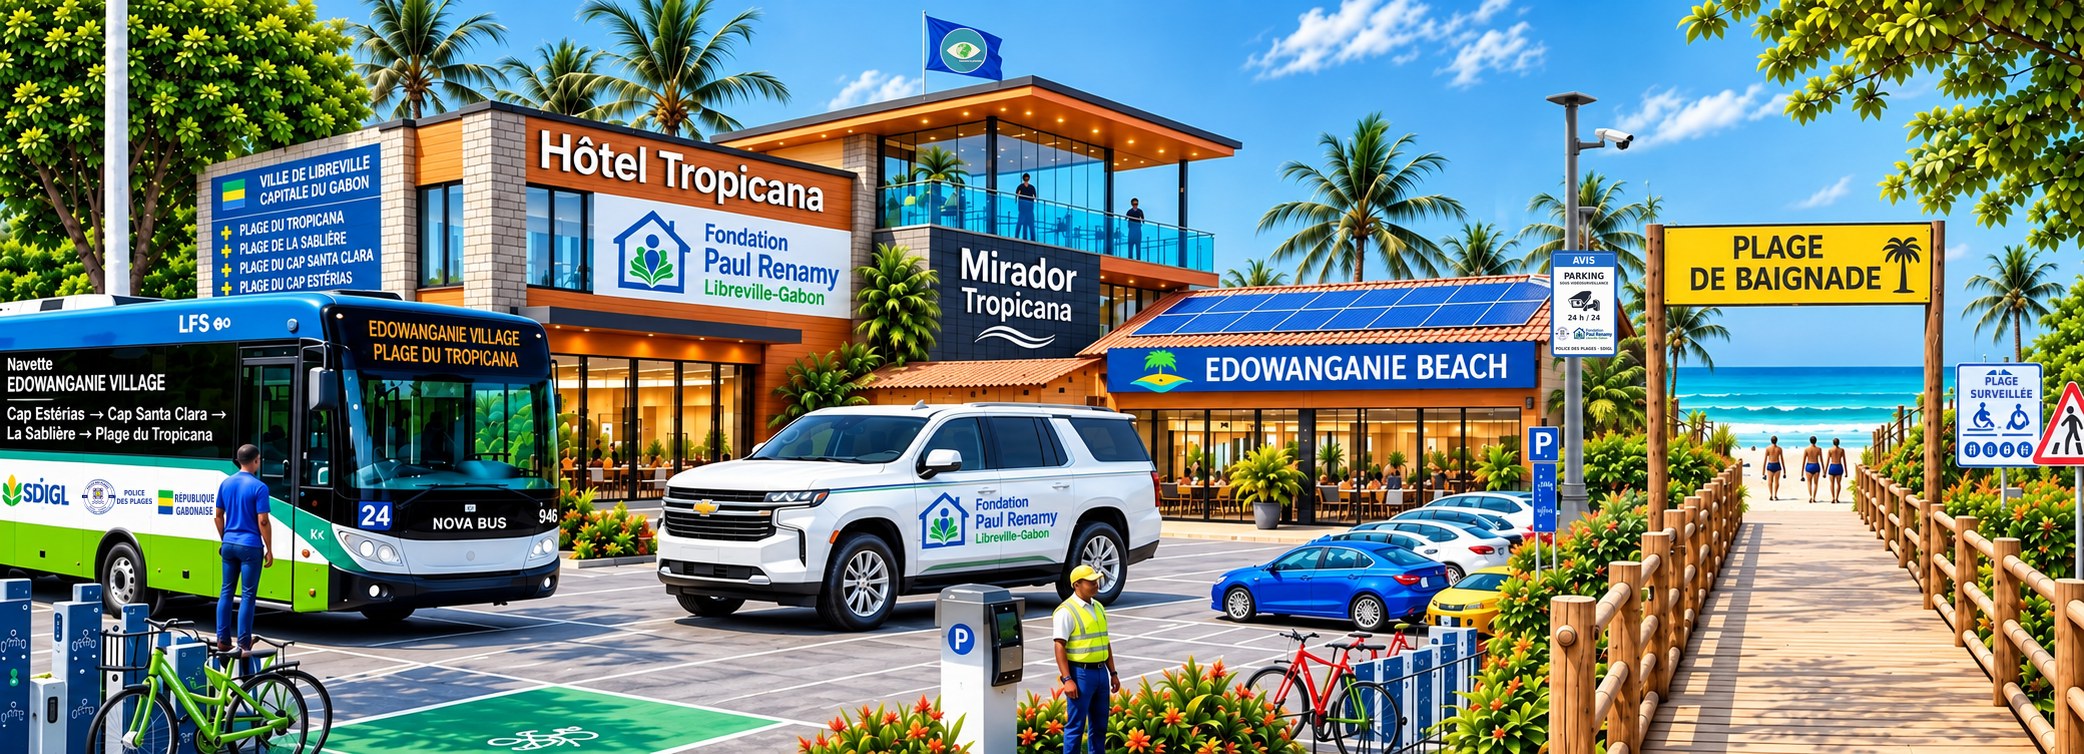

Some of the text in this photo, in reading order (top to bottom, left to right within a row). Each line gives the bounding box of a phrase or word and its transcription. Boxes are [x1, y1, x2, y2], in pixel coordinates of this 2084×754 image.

[260, 155, 370, 188] VILLE DE LIBREVILLE
[541, 129, 824, 213] Hôtel Tropicana
[260, 175, 369, 205] CAPITALE DU GABON
[239, 210, 344, 236] PLAGE DU TROPICANA
[239, 240, 269, 255] PLAGE
[271, 238, 284, 251] DE
[286, 236, 299, 250] LA
[704, 223, 788, 251] Fondation
[1733, 235, 1823, 260] PLAGE
[239, 248, 374, 274] PLAGE DU CAP SANTA CLARA
[704, 248, 840, 292] Paul Renamy
[961, 247, 1077, 292] Mirador
[1572, 256, 1595, 265] AVIS
[239, 270, 353, 294] PLAGE DU CAP ESTÉRIAS
[1564, 272, 1604, 280] PARKING
[1690, 266, 1881, 291] DE BAIGNADE
[704, 279, 825, 306] Libreville-Gabon
[961, 287, 1072, 322] Tropicana
[179, 313, 210, 334] LFS
[368, 320, 520, 347] EDOWANGANIE VILLAGE
[7, 357, 53, 372] Navette
[373, 343, 519, 368] PLAGE DU TROPICANA
[1205, 353, 1507, 382] EDOWANGANIE BEACH
[7, 373, 166, 393] EDOWANGANIE VILLAGE
[1985, 376, 2018, 386] PLAGE
[1970, 387, 2033, 399] SURVEILLÉE
[7, 406, 32, 424] Cap
[107, 406, 132, 424] Cap
[135, 406, 171, 421] Santa
[174, 406, 208, 421] Clara
[7, 425, 213, 444] La Sablière Plage du Tropicana
[1535, 432, 1552, 455] P
[23, 481, 70, 506] SDIGL
[116, 497, 153, 505] DES PLAGES
[174, 491, 215, 504] RÉPUBLIQUE
[975, 496, 1029, 511] Fondation
[175, 506, 213, 516] GABONAISE
[361, 504, 390, 527] 24
[538, 508, 558, 524] 946
[975, 511, 1058, 529] Paul Renamy
[432, 517, 507, 530] NOVA BUS
[975, 529, 1050, 544] Libreville-Gabon
[955, 628, 969, 650] P
